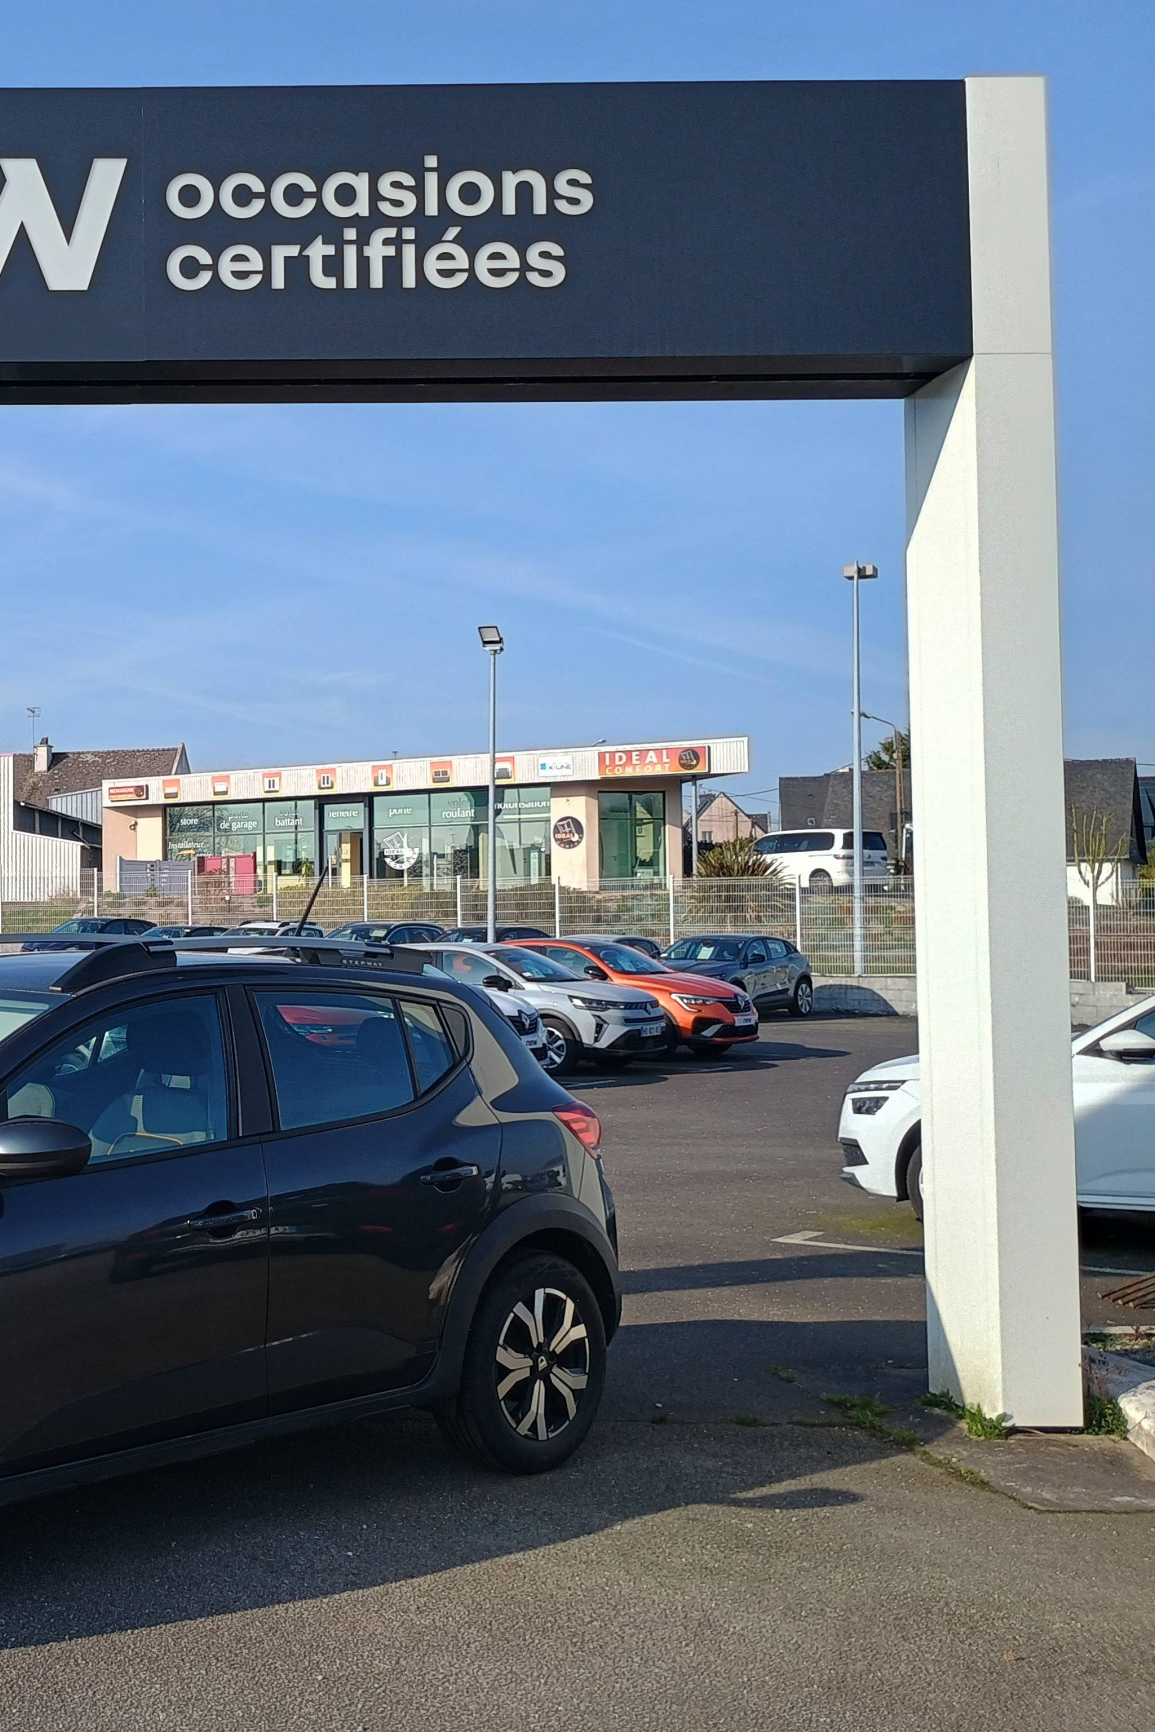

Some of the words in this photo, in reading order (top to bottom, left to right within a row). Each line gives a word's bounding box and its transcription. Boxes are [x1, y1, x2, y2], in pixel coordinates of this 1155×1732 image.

[165, 155, 594, 219] occasions
[166, 226, 567, 291] certifiées
[605, 750, 671, 766] IDEAL
[606, 763, 671, 775] CONFORT
[441, 808, 475, 819] roulant
[179, 817, 199, 826] store
[219, 819, 230, 829] de
[231, 820, 258, 832] garage
[275, 817, 303, 827] battant
[341, 959, 383, 968] STEPWAY
